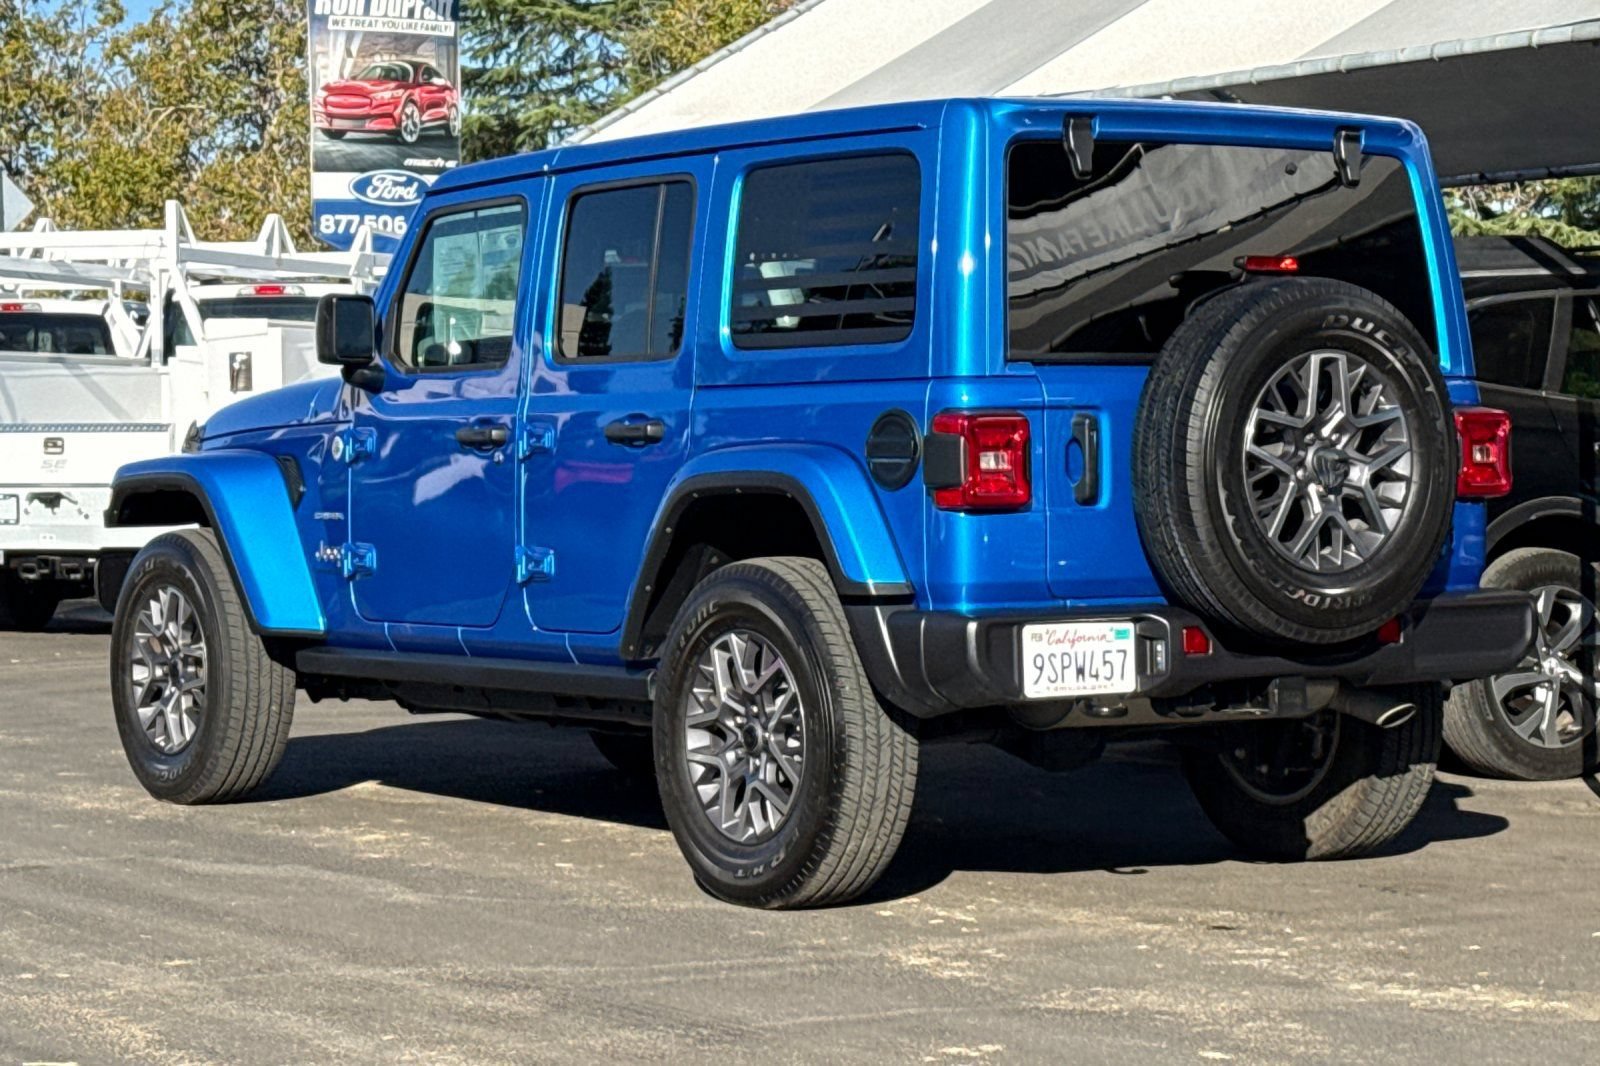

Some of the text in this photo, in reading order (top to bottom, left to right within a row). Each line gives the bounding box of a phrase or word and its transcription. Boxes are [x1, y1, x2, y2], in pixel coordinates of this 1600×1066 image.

[332, 18, 347, 27] WE
[350, 18, 379, 28] TREAT
[381, 20, 400, 30] YOU
[401, 21, 418, 31] LIKE
[366, 174, 418, 200] Ford
[1047, 628, 1108, 649] California
[1032, 649, 1128, 686] 9SPW457
